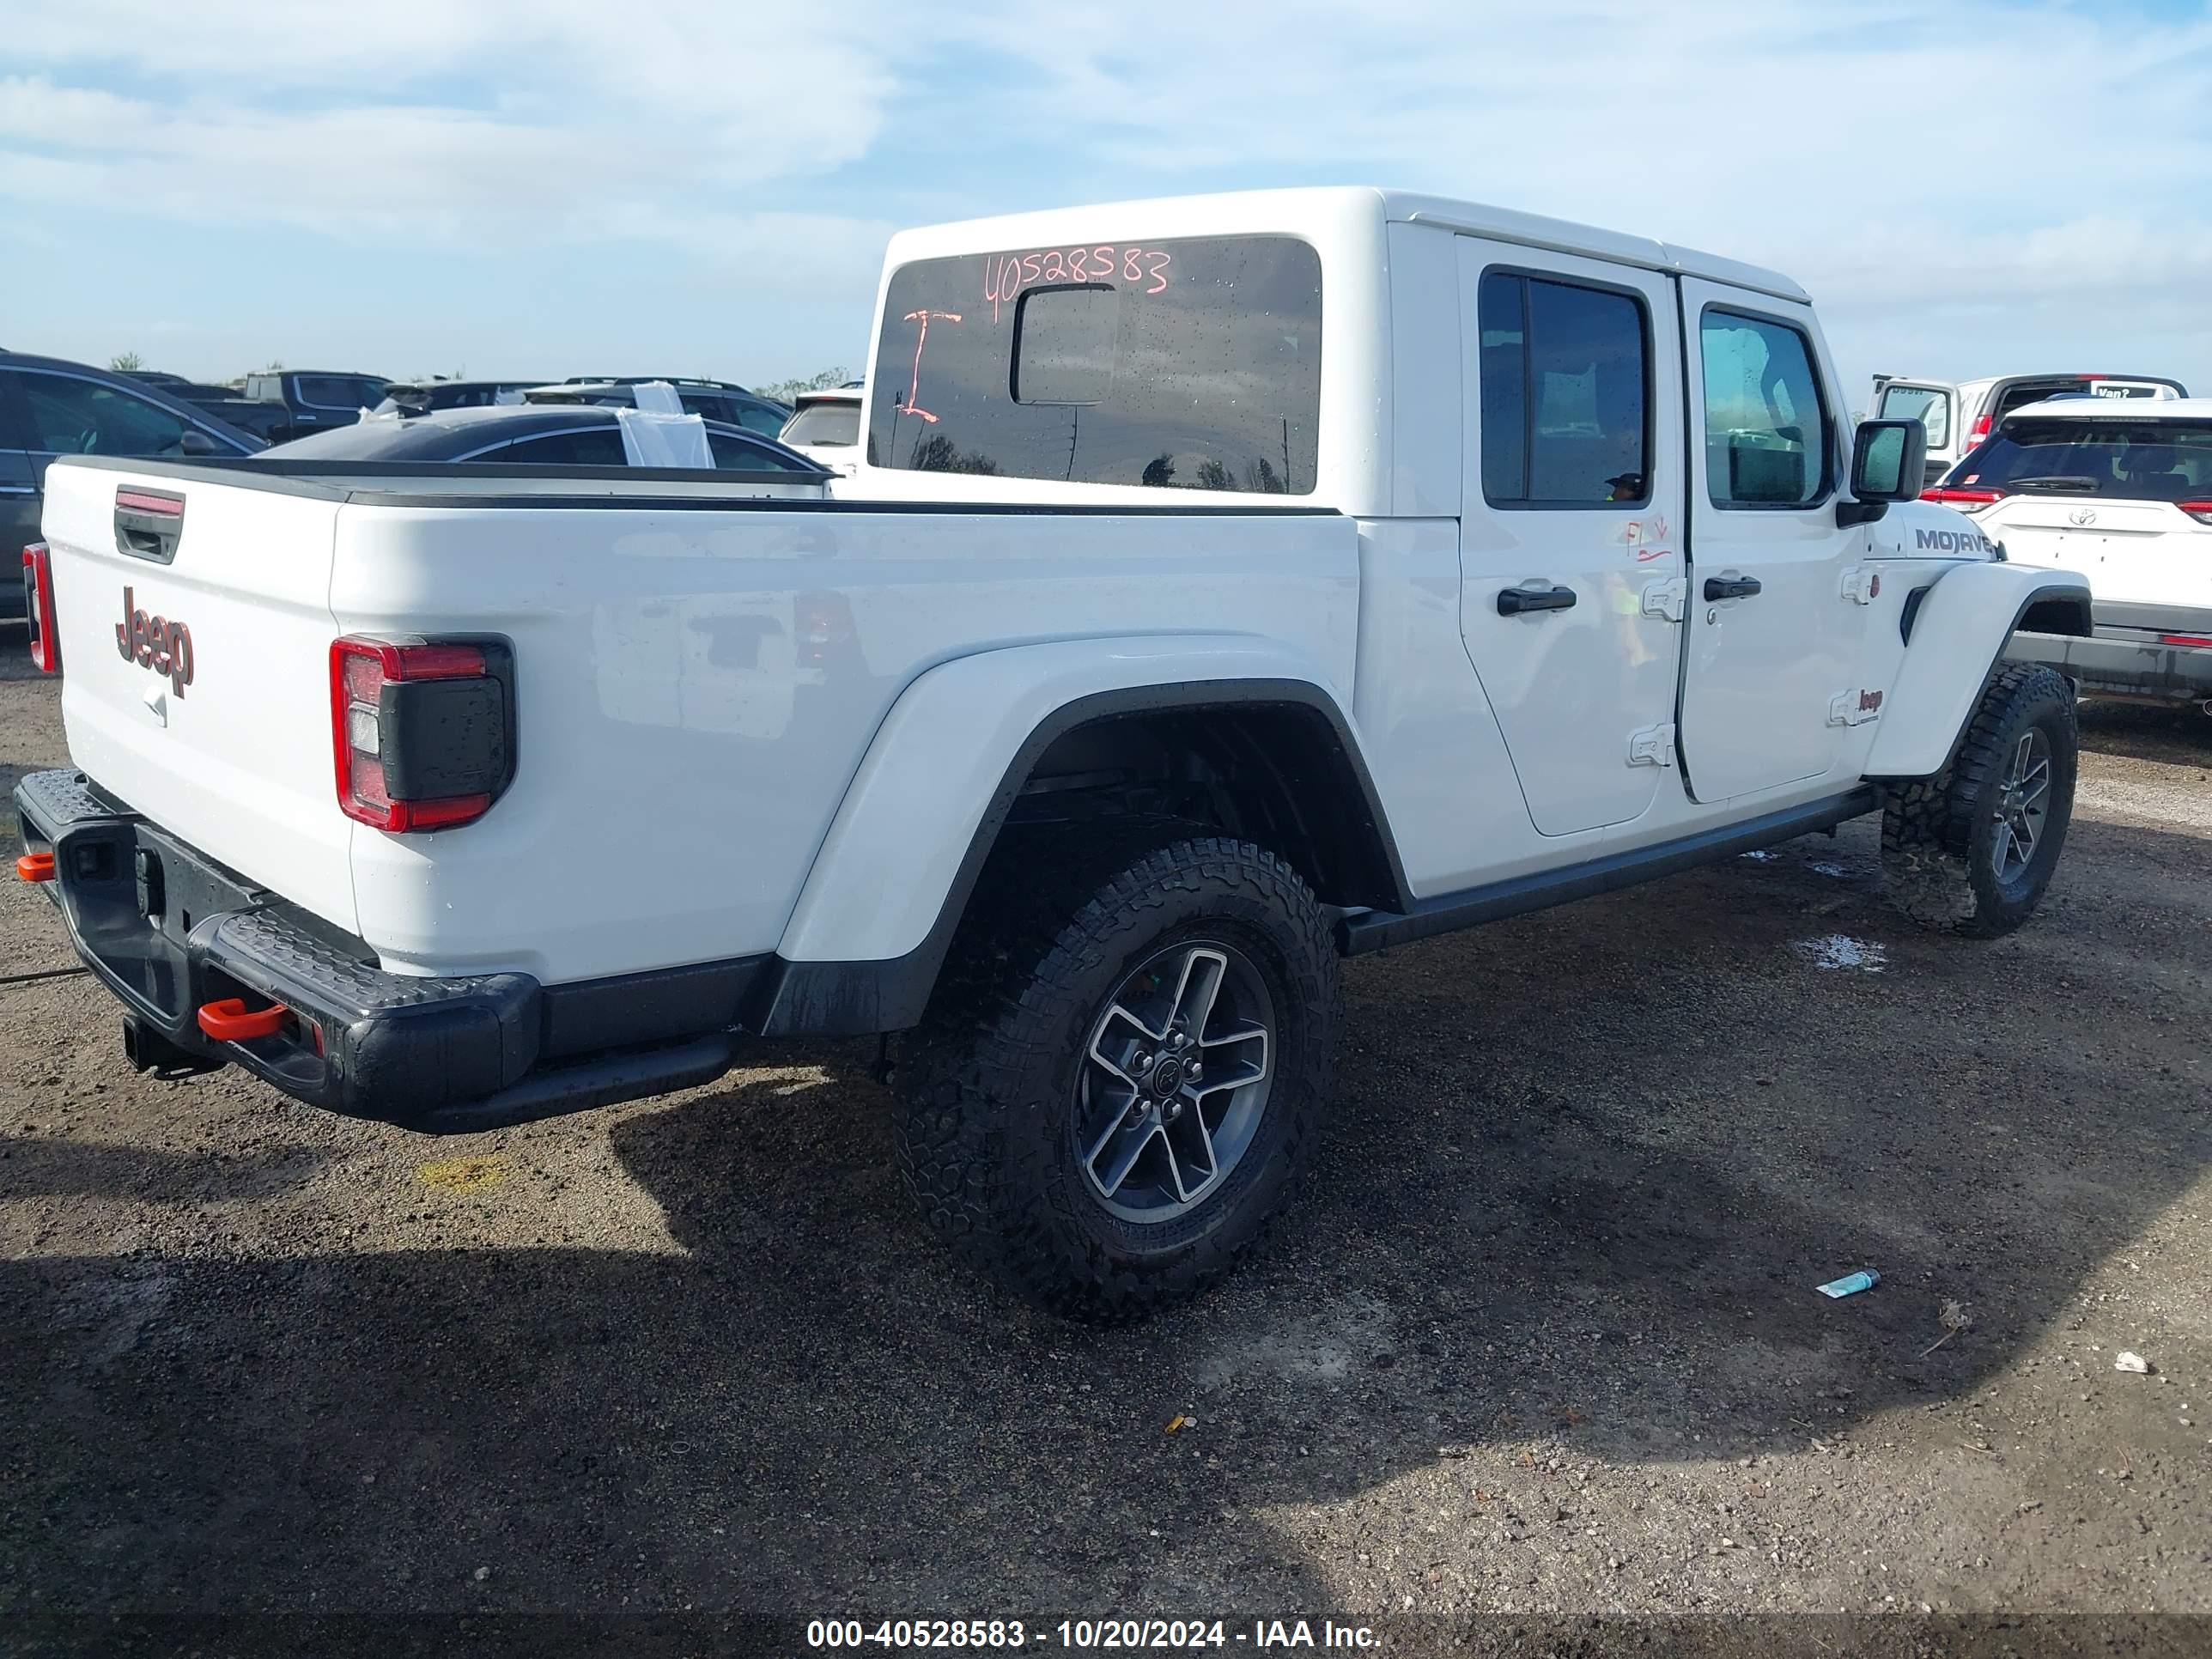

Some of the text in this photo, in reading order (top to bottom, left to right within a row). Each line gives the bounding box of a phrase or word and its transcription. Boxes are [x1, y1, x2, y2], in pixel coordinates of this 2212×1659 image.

[985, 246, 1171, 325] 40528583
[1916, 528, 1993, 554] MOJAVE
[115, 585, 194, 700] Jeep
[1858, 689, 1883, 713] Jeep
